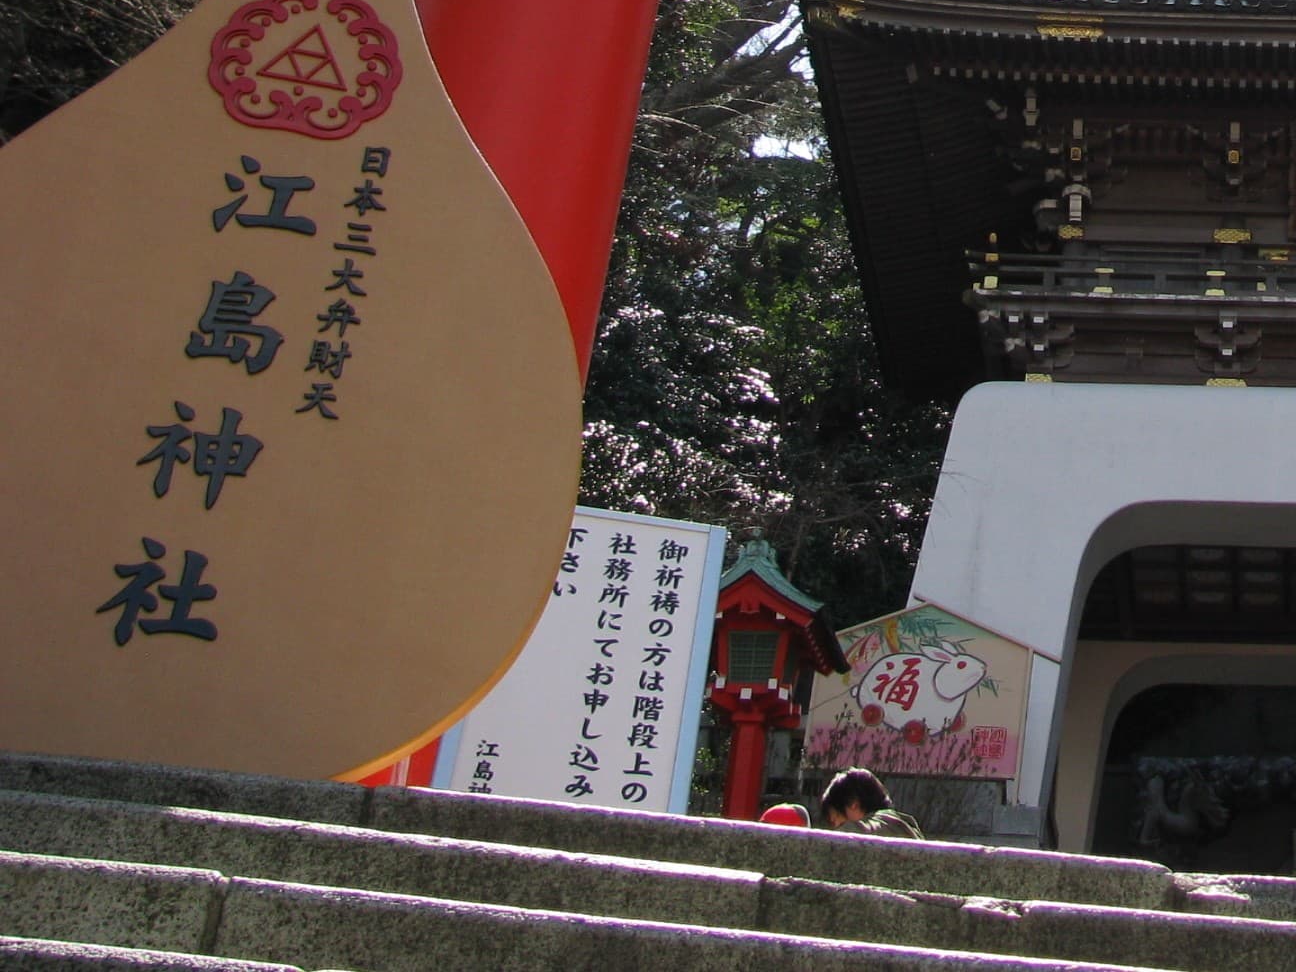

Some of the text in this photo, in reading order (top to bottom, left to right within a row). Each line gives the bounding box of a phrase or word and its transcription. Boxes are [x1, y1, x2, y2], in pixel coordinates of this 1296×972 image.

[97, 155, 317, 646] 江島神社
[297, 146, 391, 420] 日本三大弁財天
[554, 528, 588, 596] 下さい
[565, 533, 637, 797] 社務所にてお申し込み
[621, 539, 688, 802] 御祈祷の方は階段上の
[873, 657, 921, 711] 福
